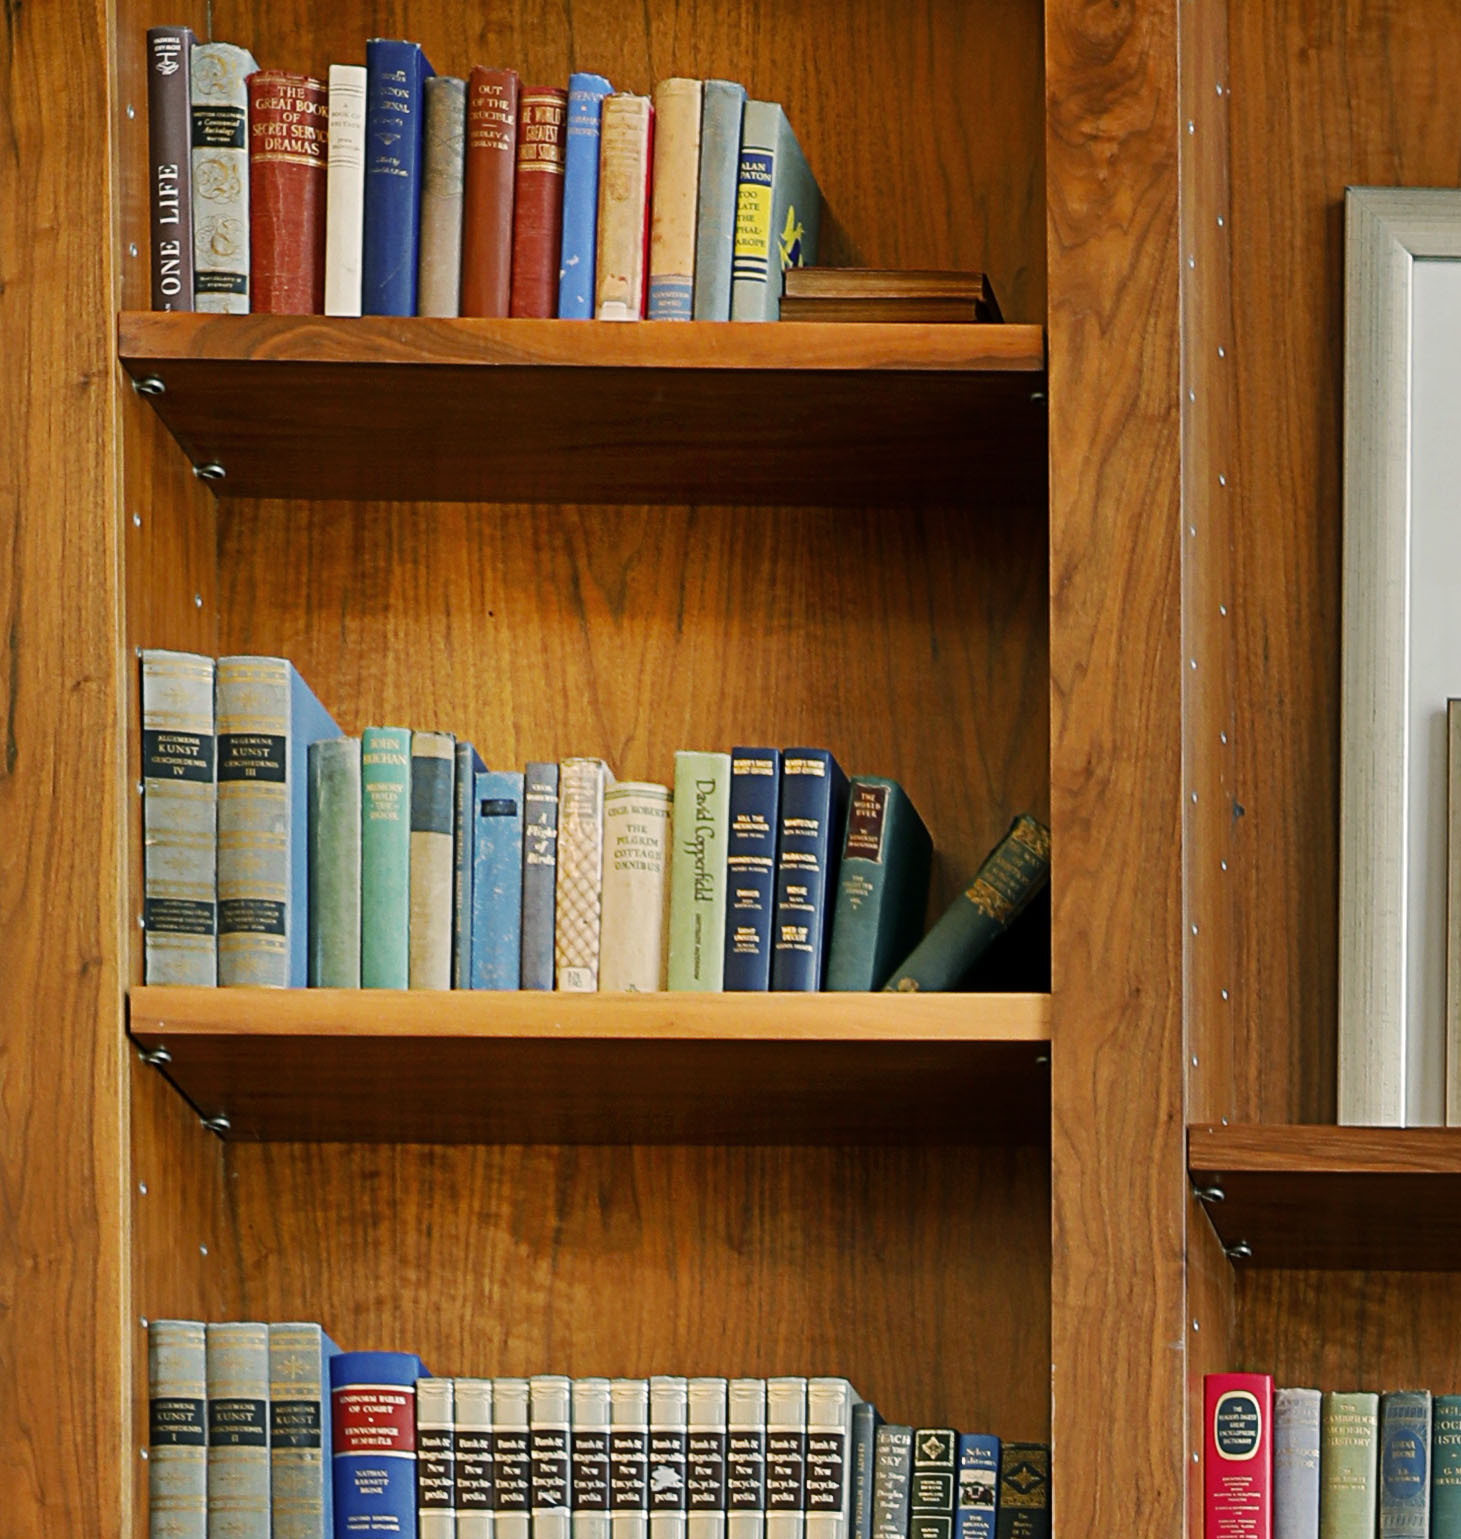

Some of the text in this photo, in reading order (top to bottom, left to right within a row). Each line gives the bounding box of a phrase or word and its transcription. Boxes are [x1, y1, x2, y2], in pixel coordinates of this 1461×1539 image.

[278, 86, 305, 99] THE
[479, 84, 503, 96] OUT
[256, 98, 293, 112] GREAT
[283, 112, 301, 123] OF
[264, 136, 320, 155] DRAMAS
[159, 164, 181, 296] ONE LIFE
[158, 744, 199, 756] KUNST
[232, 747, 270, 758] KUNST
[696, 778, 716, 822] David
